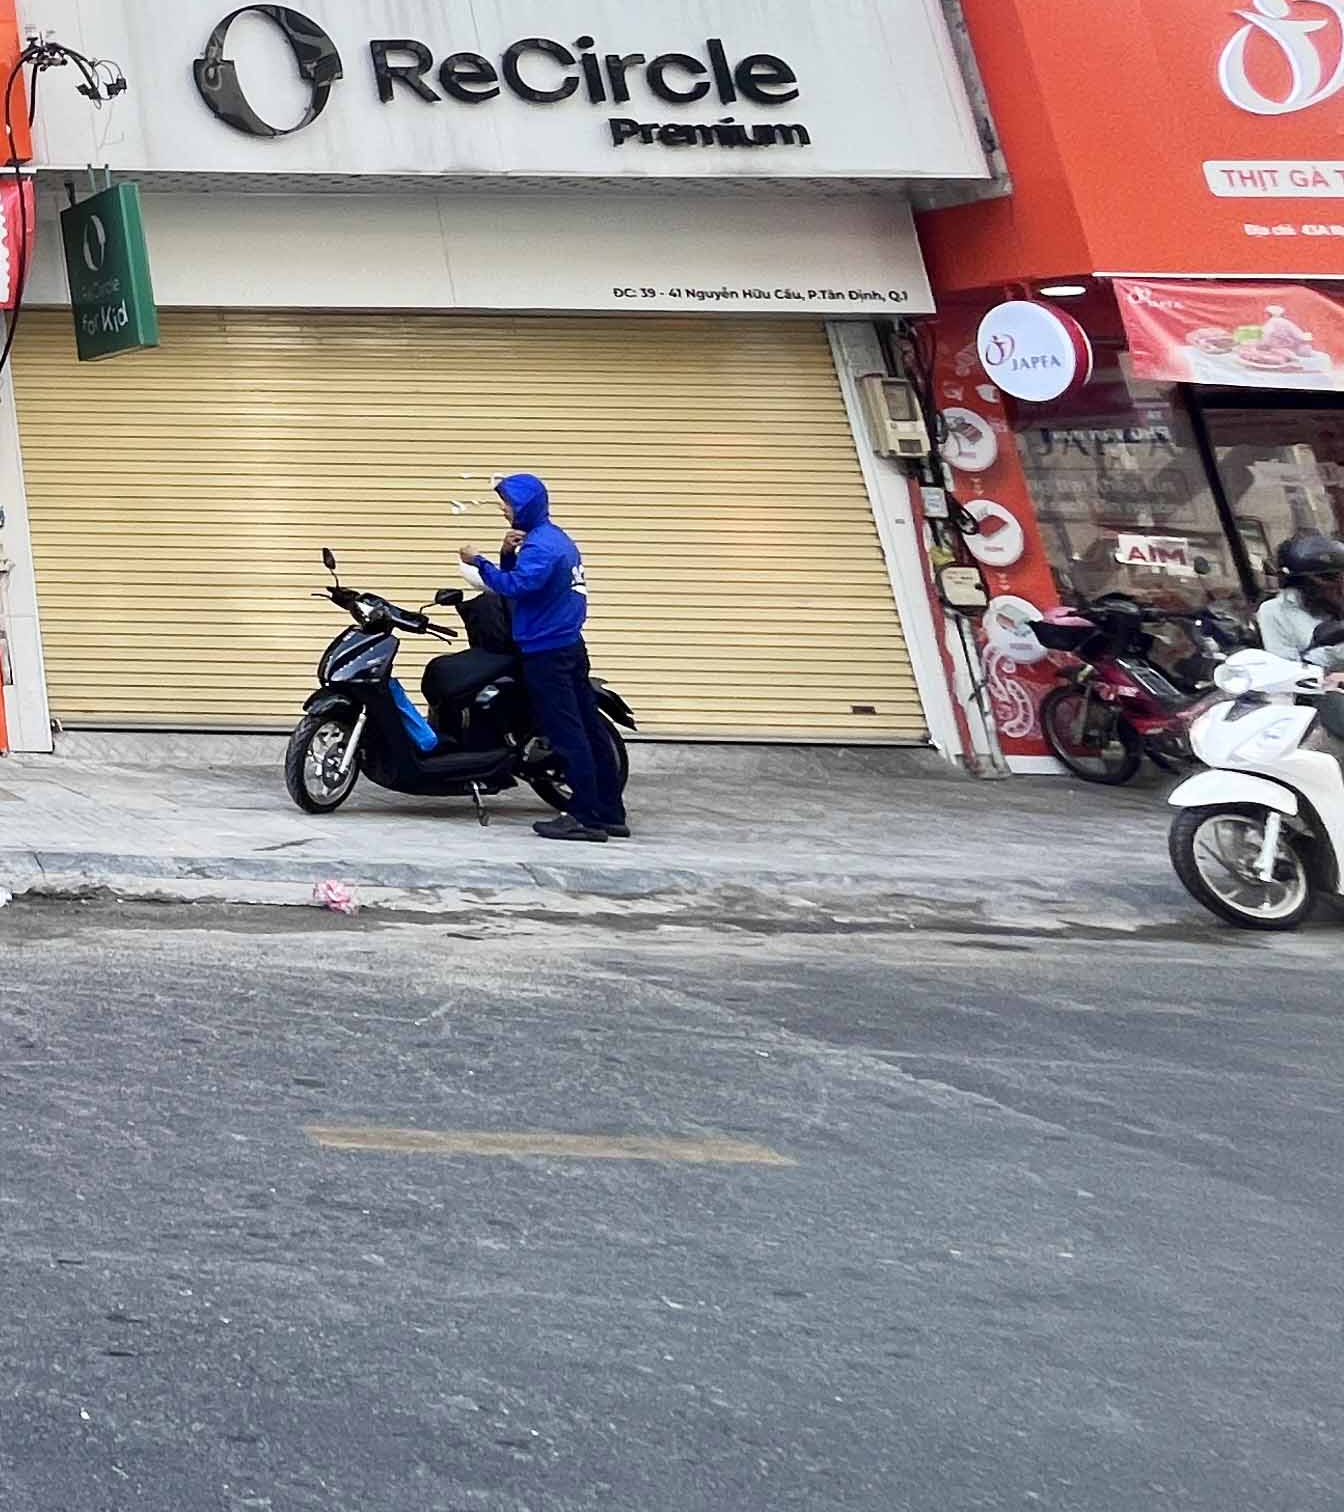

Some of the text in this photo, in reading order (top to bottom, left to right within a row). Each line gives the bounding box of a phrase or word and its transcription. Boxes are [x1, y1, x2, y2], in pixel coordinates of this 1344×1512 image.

[368, 35, 800, 106] ReCircle
[608, 117, 811, 148] Premium
[1219, 169, 1278, 191] THỊT
[639, 288, 657, 298] 39
[667, 288, 683, 298] 41
[888, 290, 908, 302] Q.1
[100, 298, 129, 333] Kid
[1011, 354, 1062, 372] JAPFA
